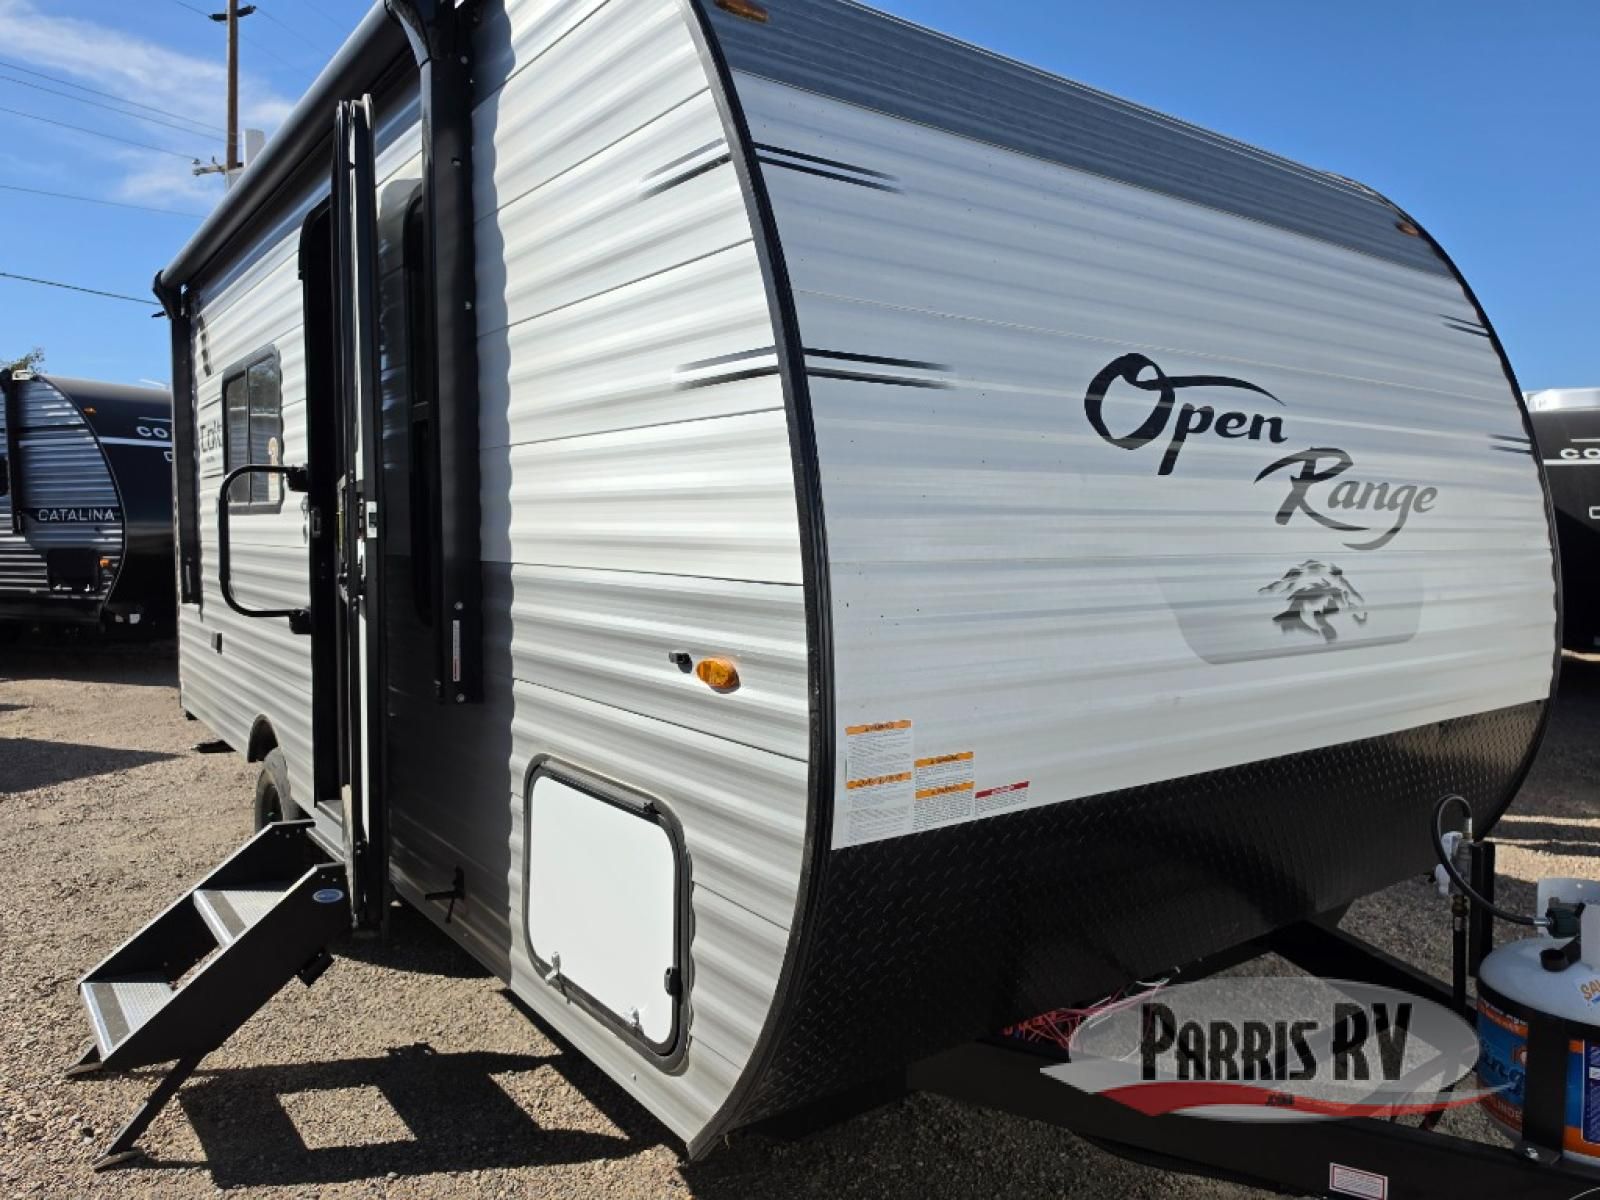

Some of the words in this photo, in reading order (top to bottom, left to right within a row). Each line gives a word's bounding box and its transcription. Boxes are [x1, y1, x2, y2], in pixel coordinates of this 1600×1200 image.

[1084, 352, 1288, 475] Open
[38, 508, 115, 521] CATALINA
[1254, 447, 1438, 550] Range
